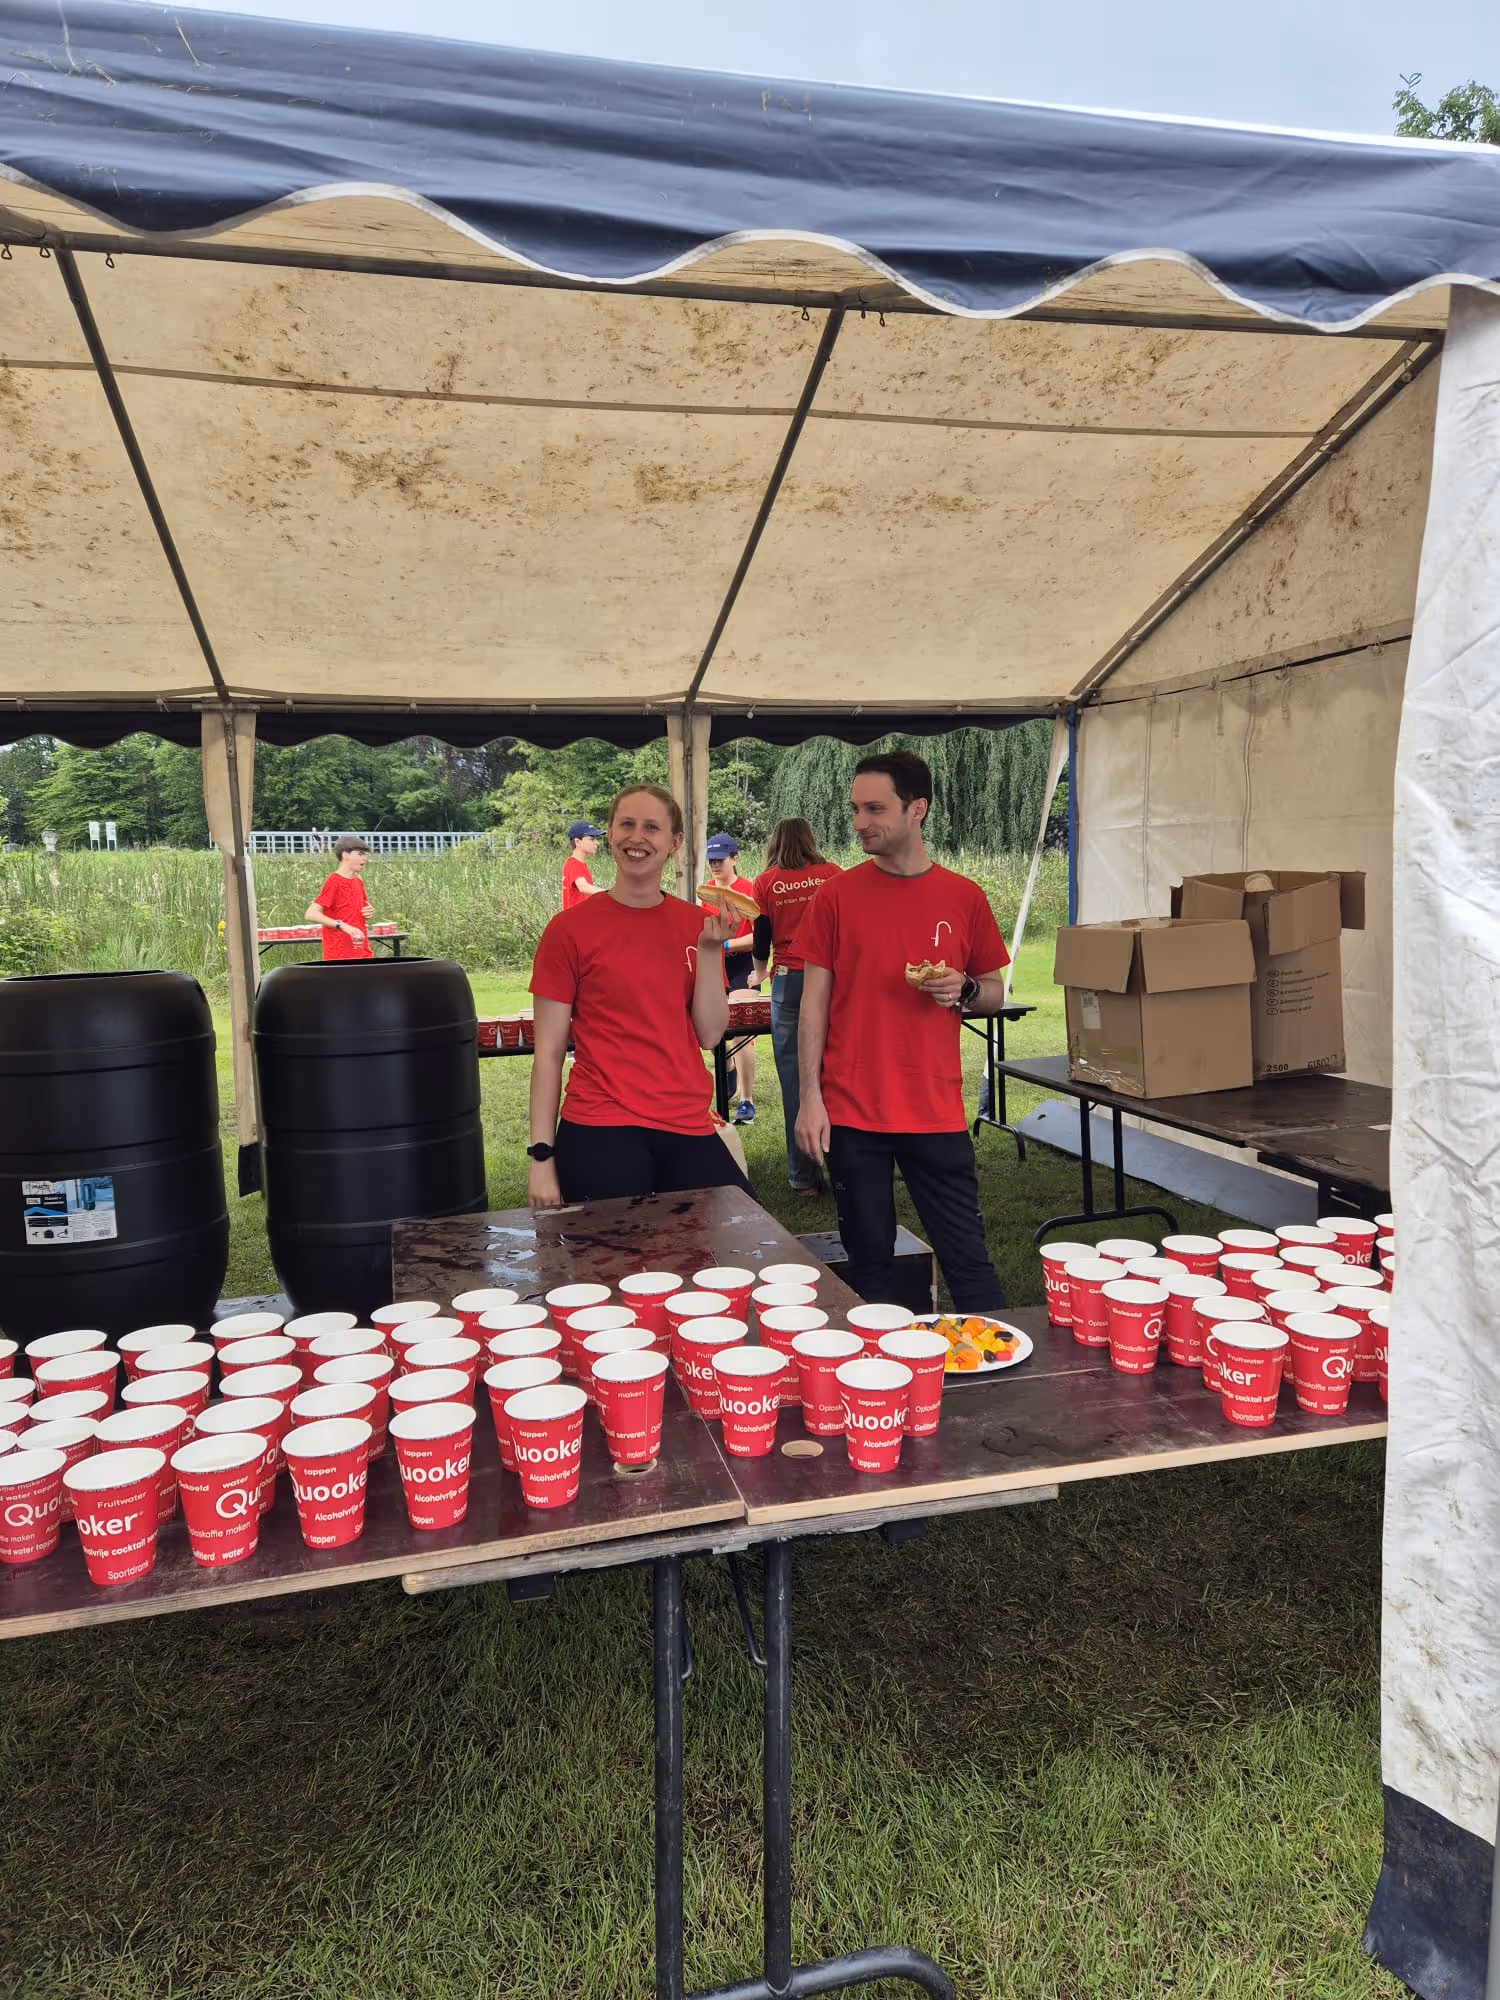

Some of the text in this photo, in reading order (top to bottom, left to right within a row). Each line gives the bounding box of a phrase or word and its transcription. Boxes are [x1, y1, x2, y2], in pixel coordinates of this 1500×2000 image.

[1267, 1064, 1288, 1072] 2500
[727, 1383, 753, 1393] tappen
[858, 1400, 887, 1408] tappen
[520, 1430, 548, 1439] tappen
[730, 1443, 750, 1453] tappen
[404, 1449, 433, 1458] tappen
[858, 1458, 880, 1468] tappen
[304, 1467, 337, 1477] tappen
[529, 1470, 571, 1482] Alcoholvrije
[222, 1475, 249, 1489] water
[6, 1492, 33, 1501] water
[97, 1491, 147, 1509] Fruitwater
[415, 1489, 458, 1503] Alcoholvrije
[526, 1493, 549, 1504] tappen
[315, 1503, 359, 1521] Alcoholvrije
[77, 1513, 139, 1537] oker
[411, 1515, 434, 1525] tappen
[10, 1533, 35, 1542] maken
[309, 1535, 337, 1545] tappen
[13, 1546, 33, 1556] water
[111, 1537, 146, 1556] cocktail
[222, 1547, 245, 1560] water
